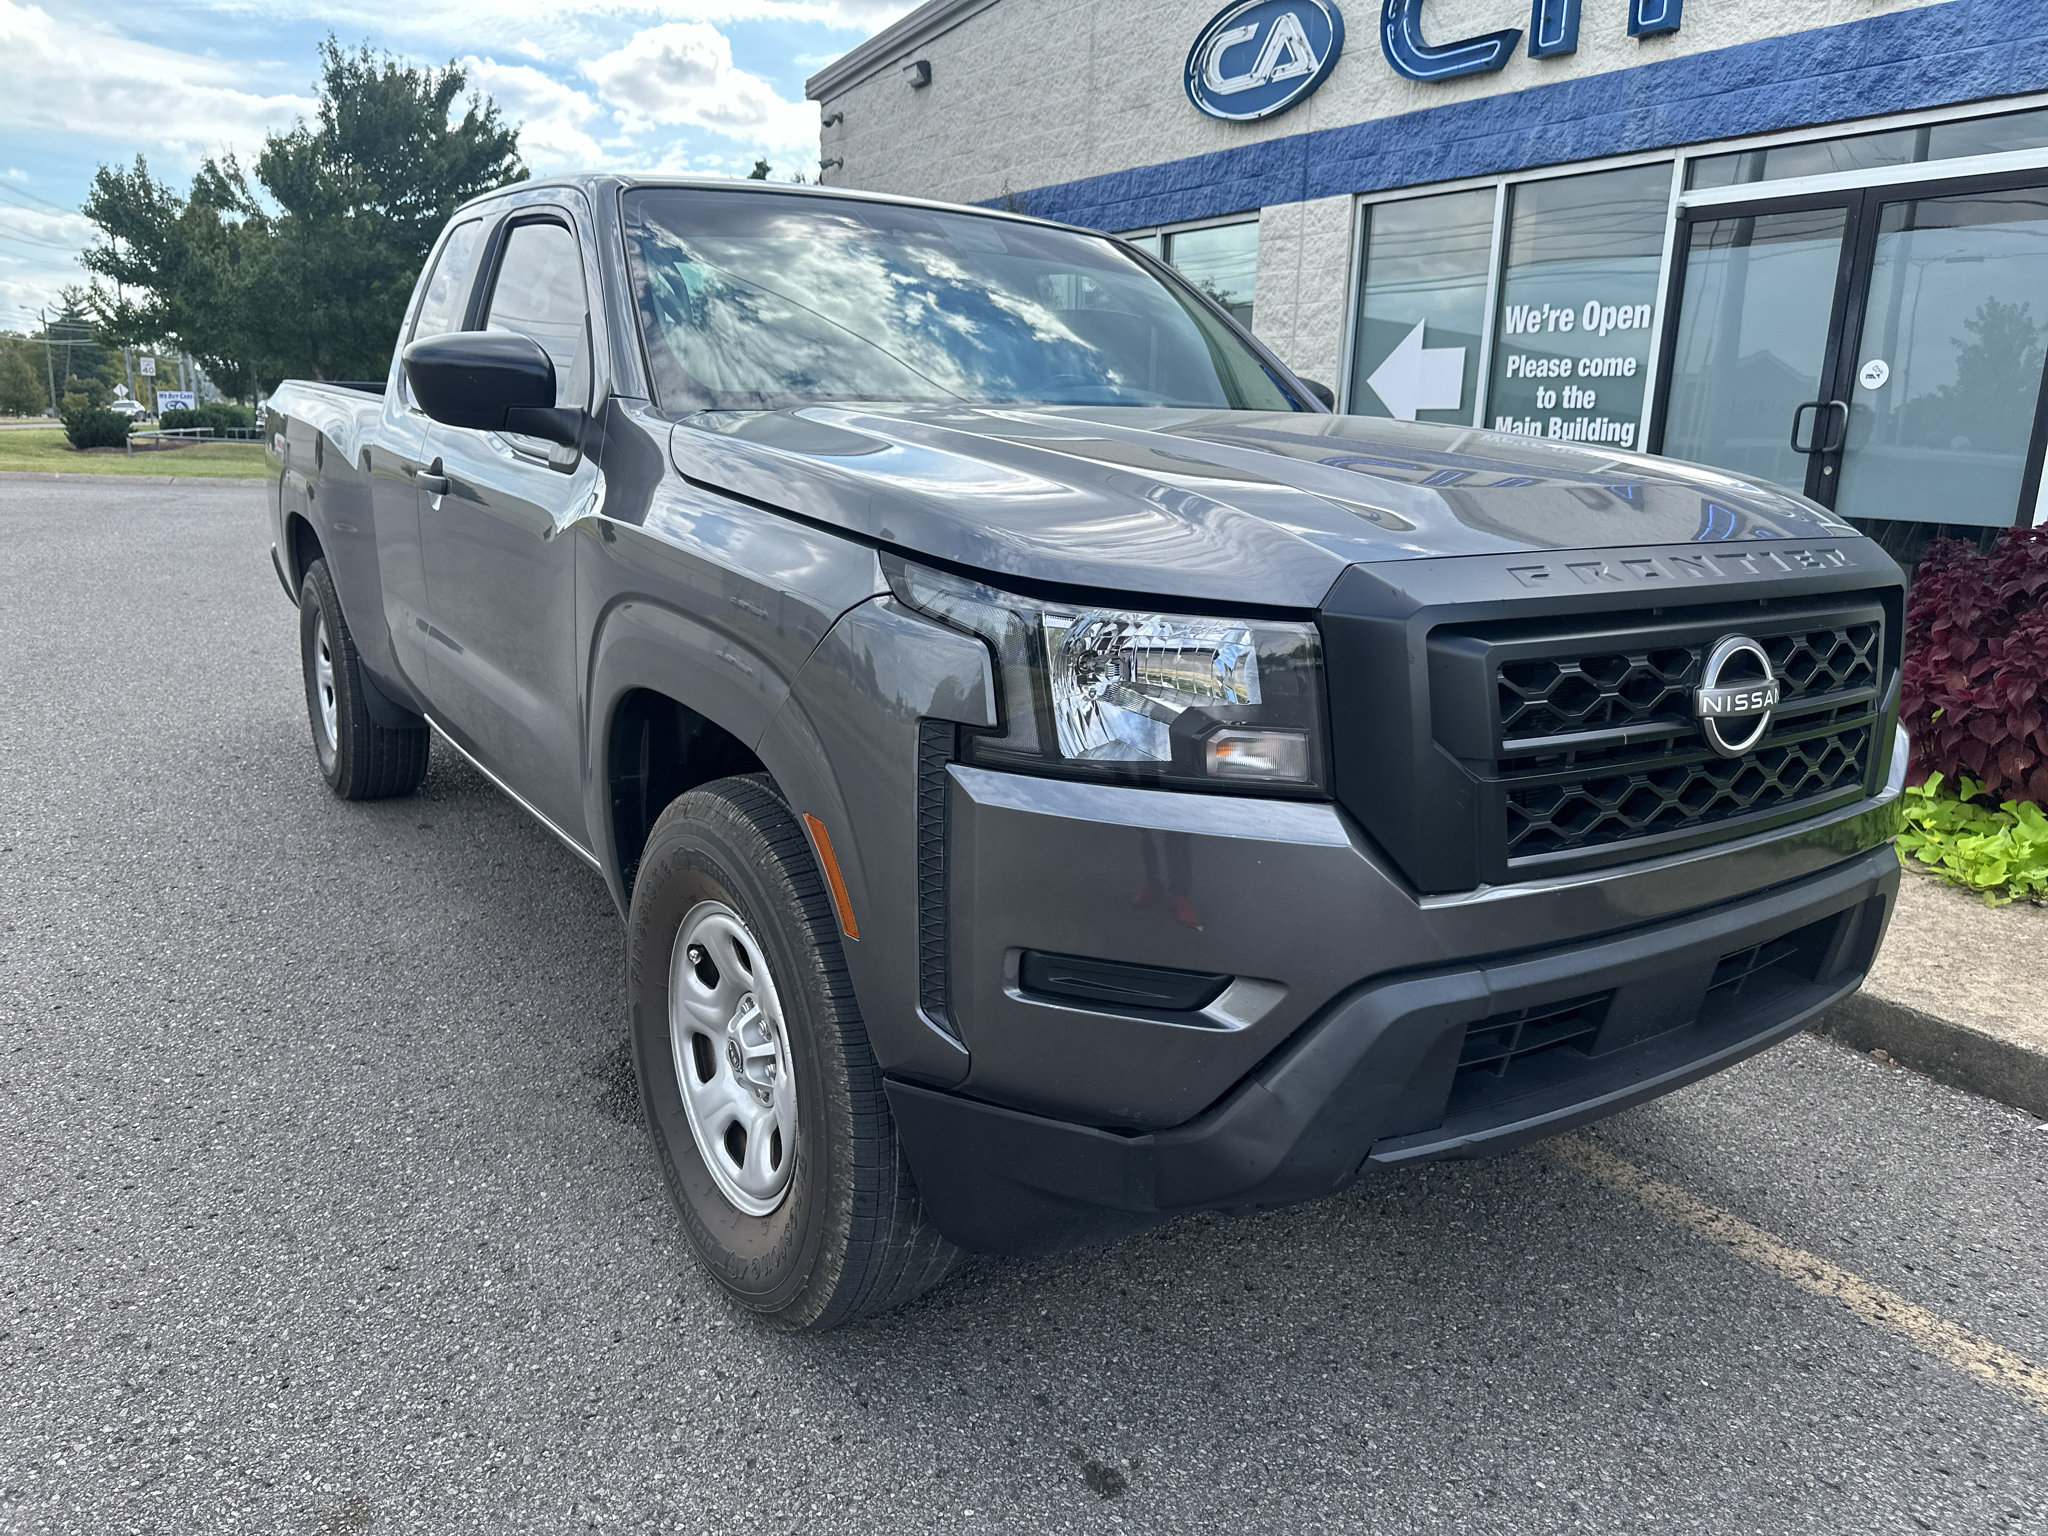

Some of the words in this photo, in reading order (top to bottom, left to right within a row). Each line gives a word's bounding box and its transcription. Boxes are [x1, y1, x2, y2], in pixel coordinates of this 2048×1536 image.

[1201, 13, 1321, 96] CA
[1582, 300, 1651, 336] Open
[1506, 355, 1572, 378] Please
[1577, 356, 1637, 377] come
[1536, 386, 1556, 409] to
[1562, 385, 1596, 409] the
[1495, 416, 1542, 437] Main
[1548, 417, 1635, 447] Building
[1506, 549, 1858, 588] FRONTIER
